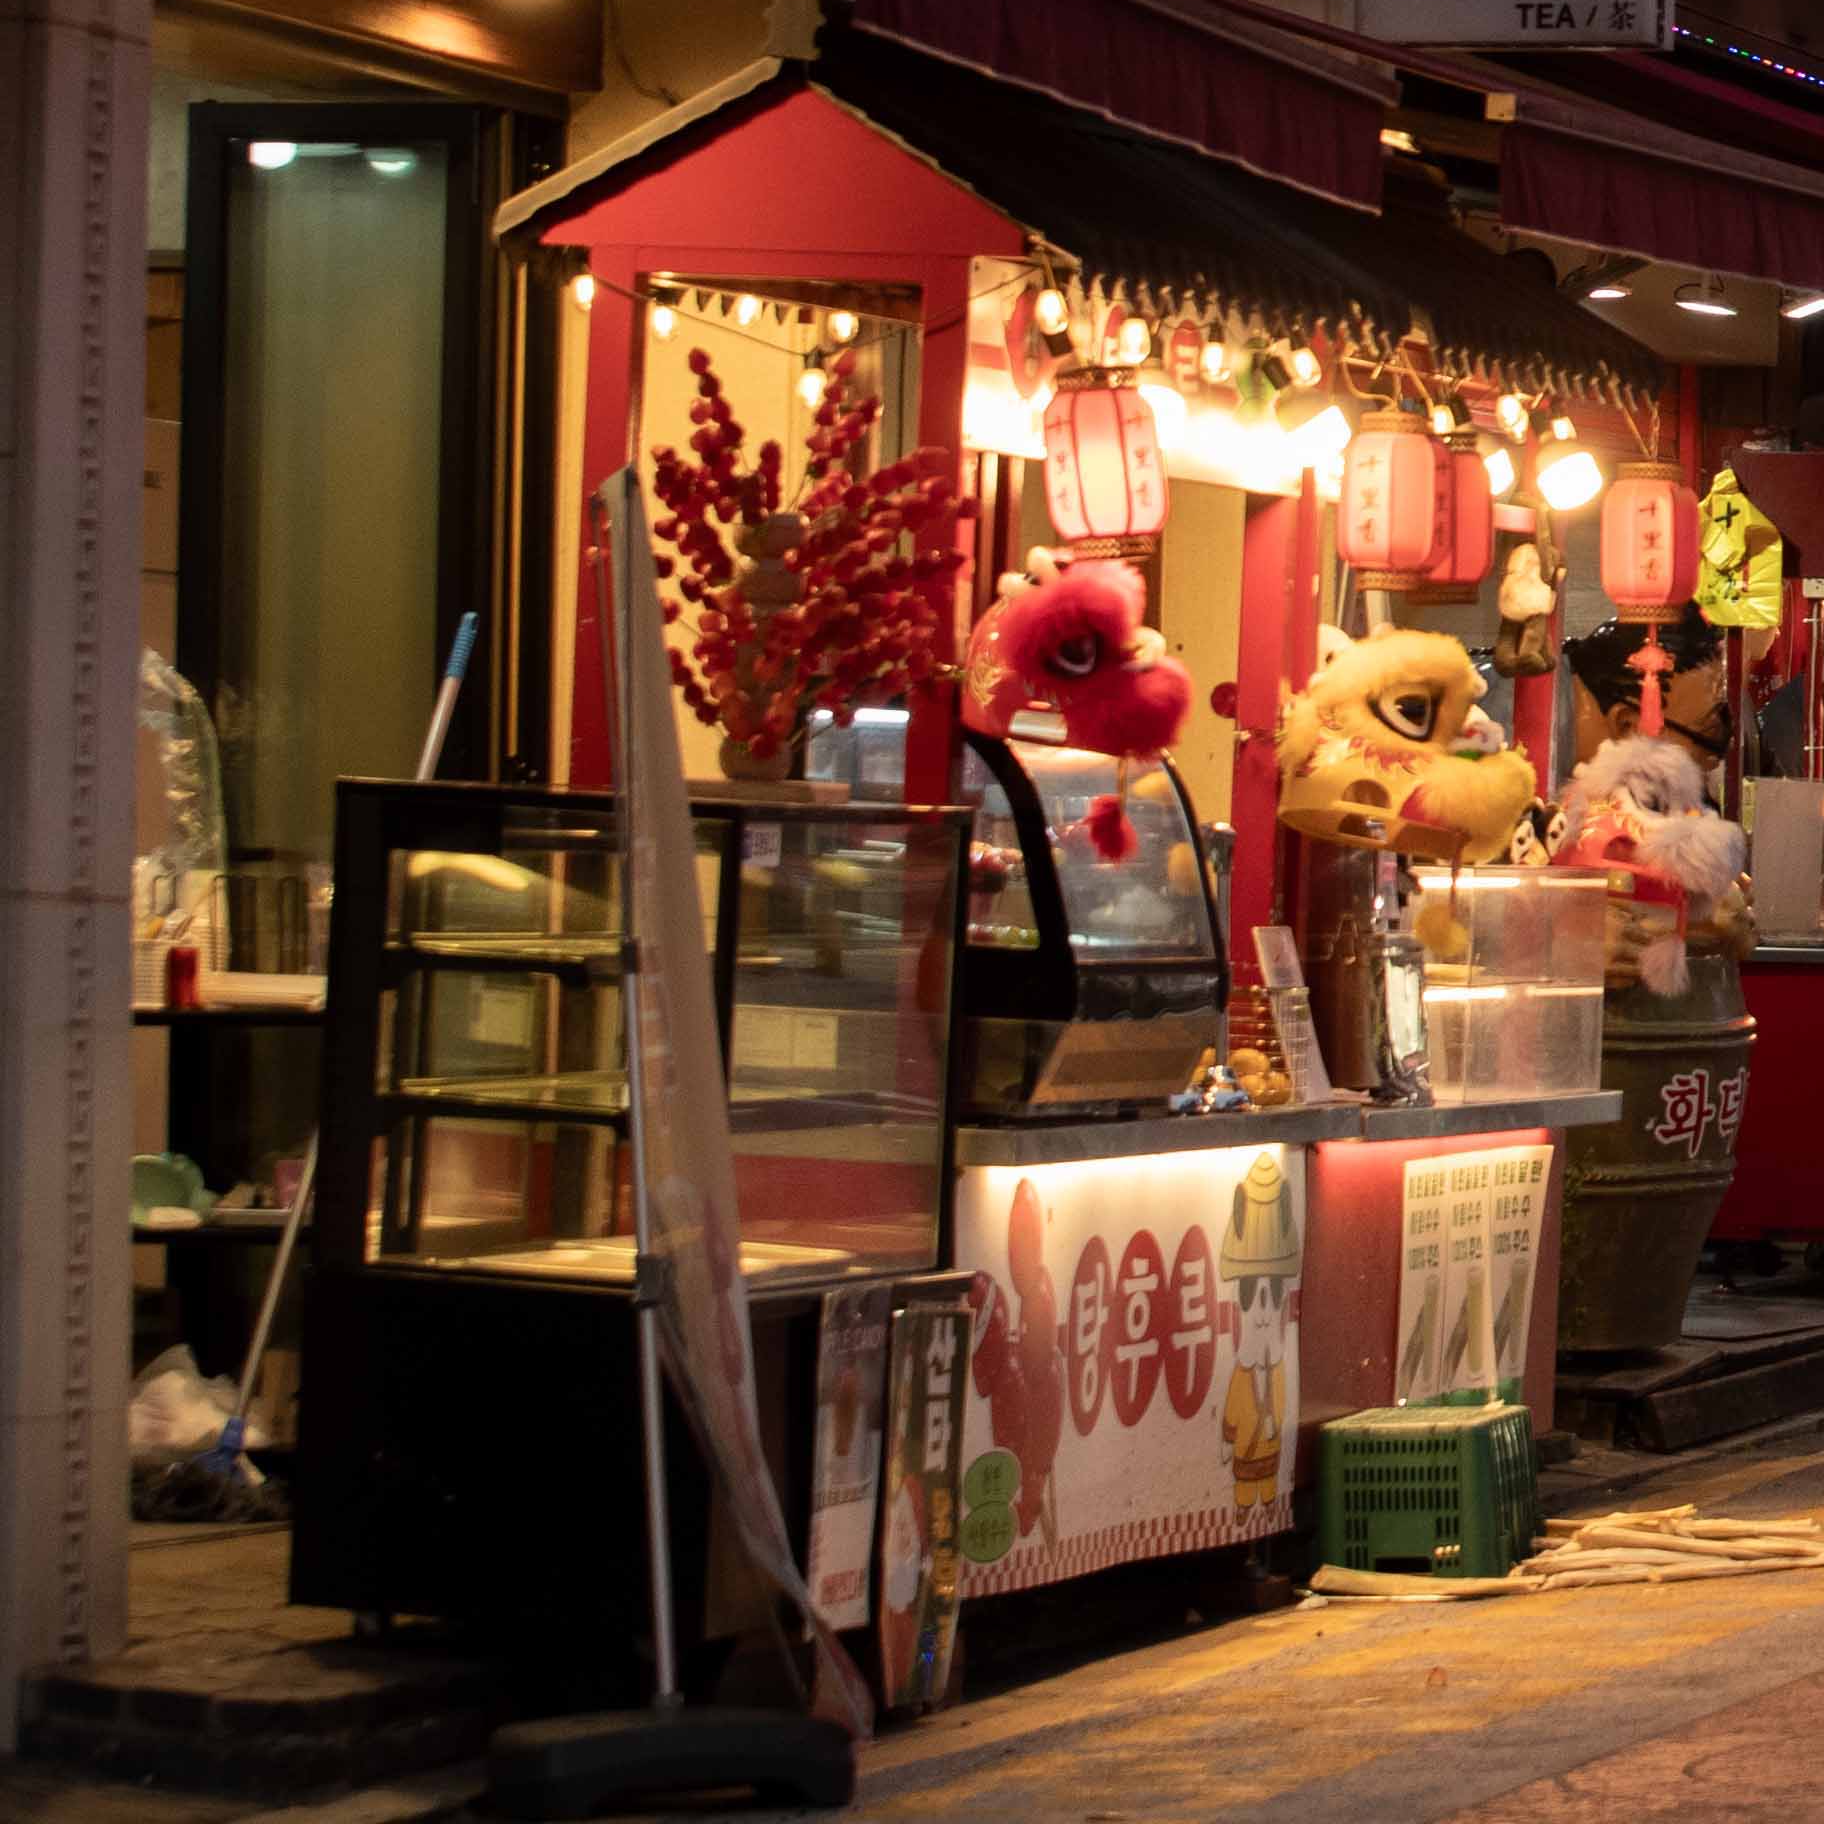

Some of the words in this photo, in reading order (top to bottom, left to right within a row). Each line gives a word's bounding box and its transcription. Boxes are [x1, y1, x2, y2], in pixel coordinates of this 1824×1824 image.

[1516, 3, 1577, 29] TEA
[1608, 0, 1637, 30] 茶
[1075, 1256, 1213, 1417] 탕후루
